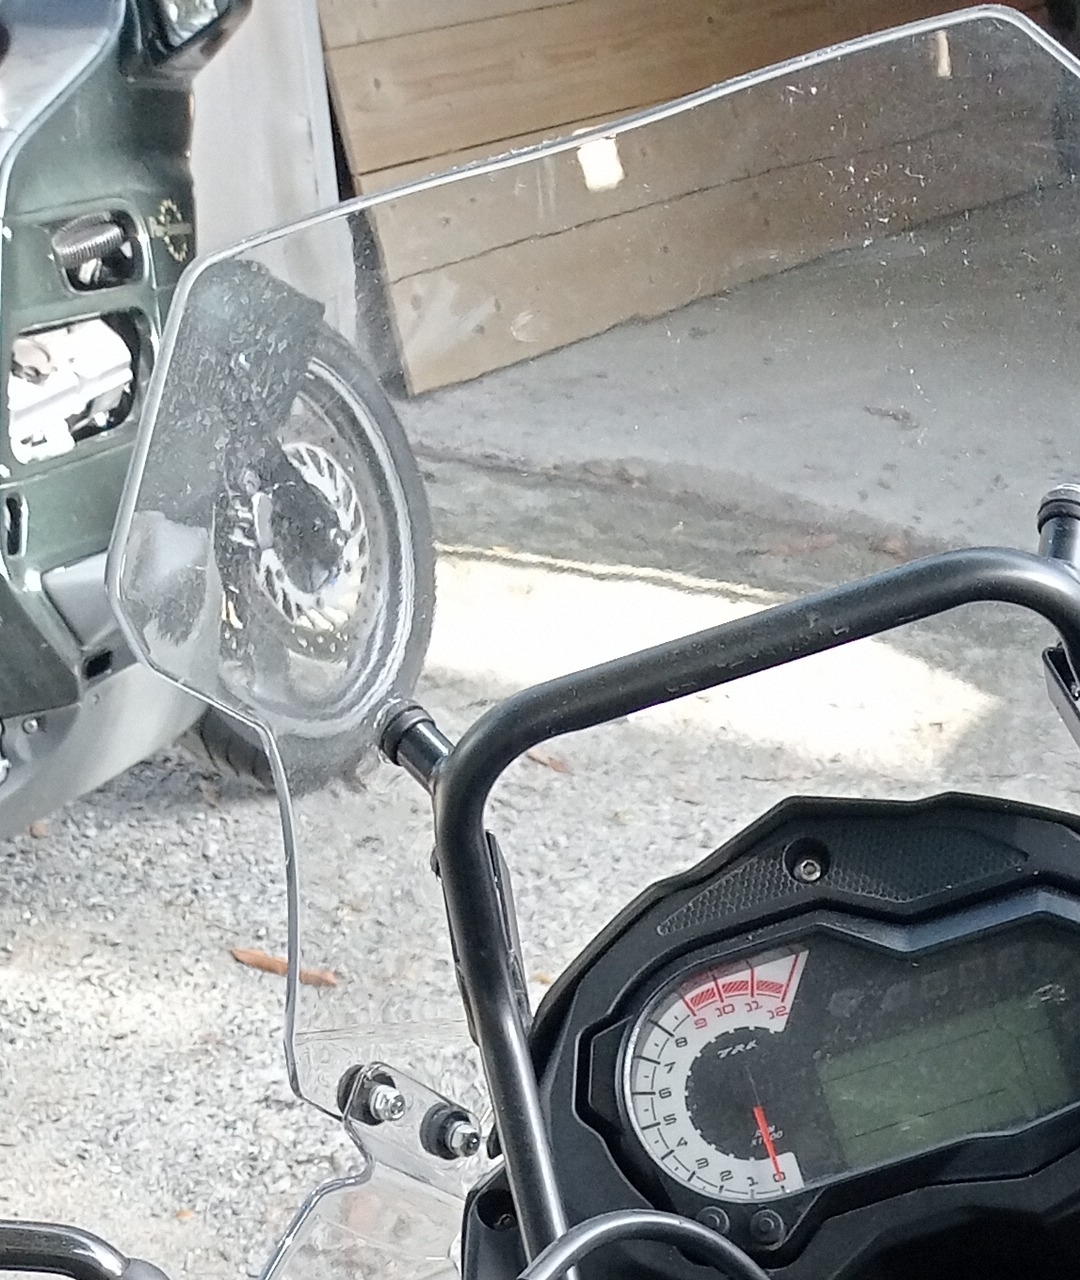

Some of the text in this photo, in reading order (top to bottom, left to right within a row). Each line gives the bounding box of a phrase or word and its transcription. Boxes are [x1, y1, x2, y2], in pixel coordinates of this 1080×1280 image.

[715, 1003, 735, 1018] 10
[766, 1005, 788, 1020] 12
[693, 1017, 708, 1030] 9
[674, 1036, 688, 1048] 8
[717, 1040, 758, 1058] TRK
[663, 1061, 676, 1074] 7
[658, 1087, 672, 1099] 6
[662, 1113, 677, 1126] 5
[676, 1136, 688, 1147] 4
[695, 1157, 709, 1170] 3
[720, 1170, 734, 1182] 2
[746, 1176, 759, 1187] 1
[772, 1171, 787, 1183] 0
